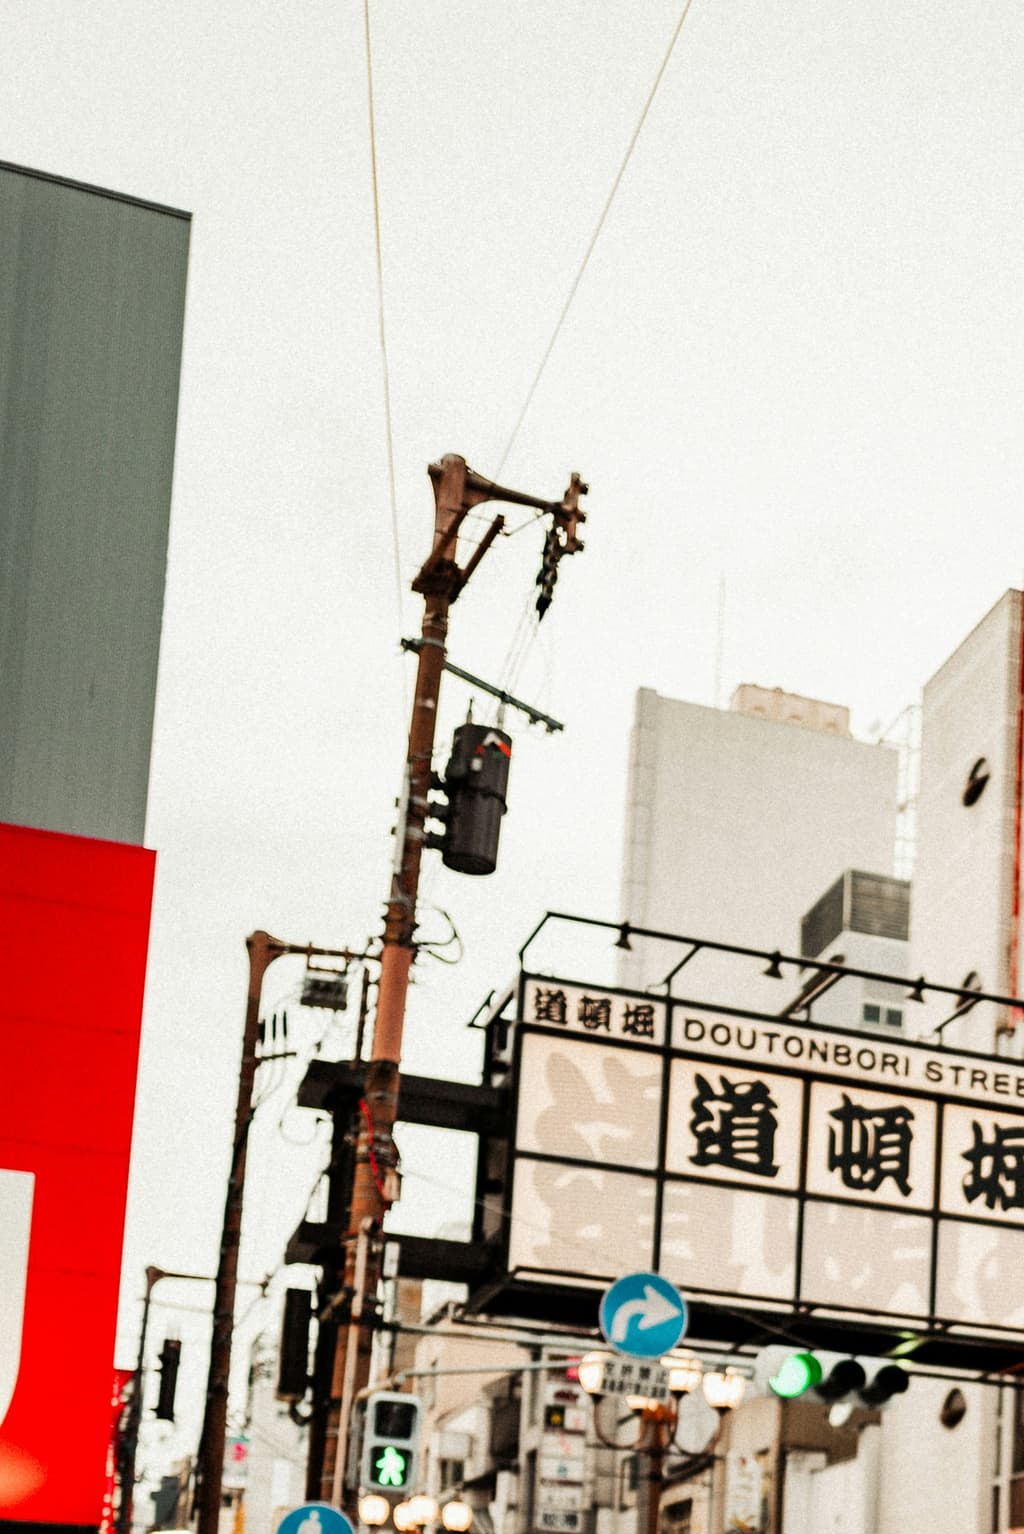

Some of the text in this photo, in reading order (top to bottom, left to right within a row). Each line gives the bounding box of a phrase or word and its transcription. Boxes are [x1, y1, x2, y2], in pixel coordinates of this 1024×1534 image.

[534, 987, 655, 1039] 道頓堀
[684, 1017, 910, 1077] DOUTONBORI
